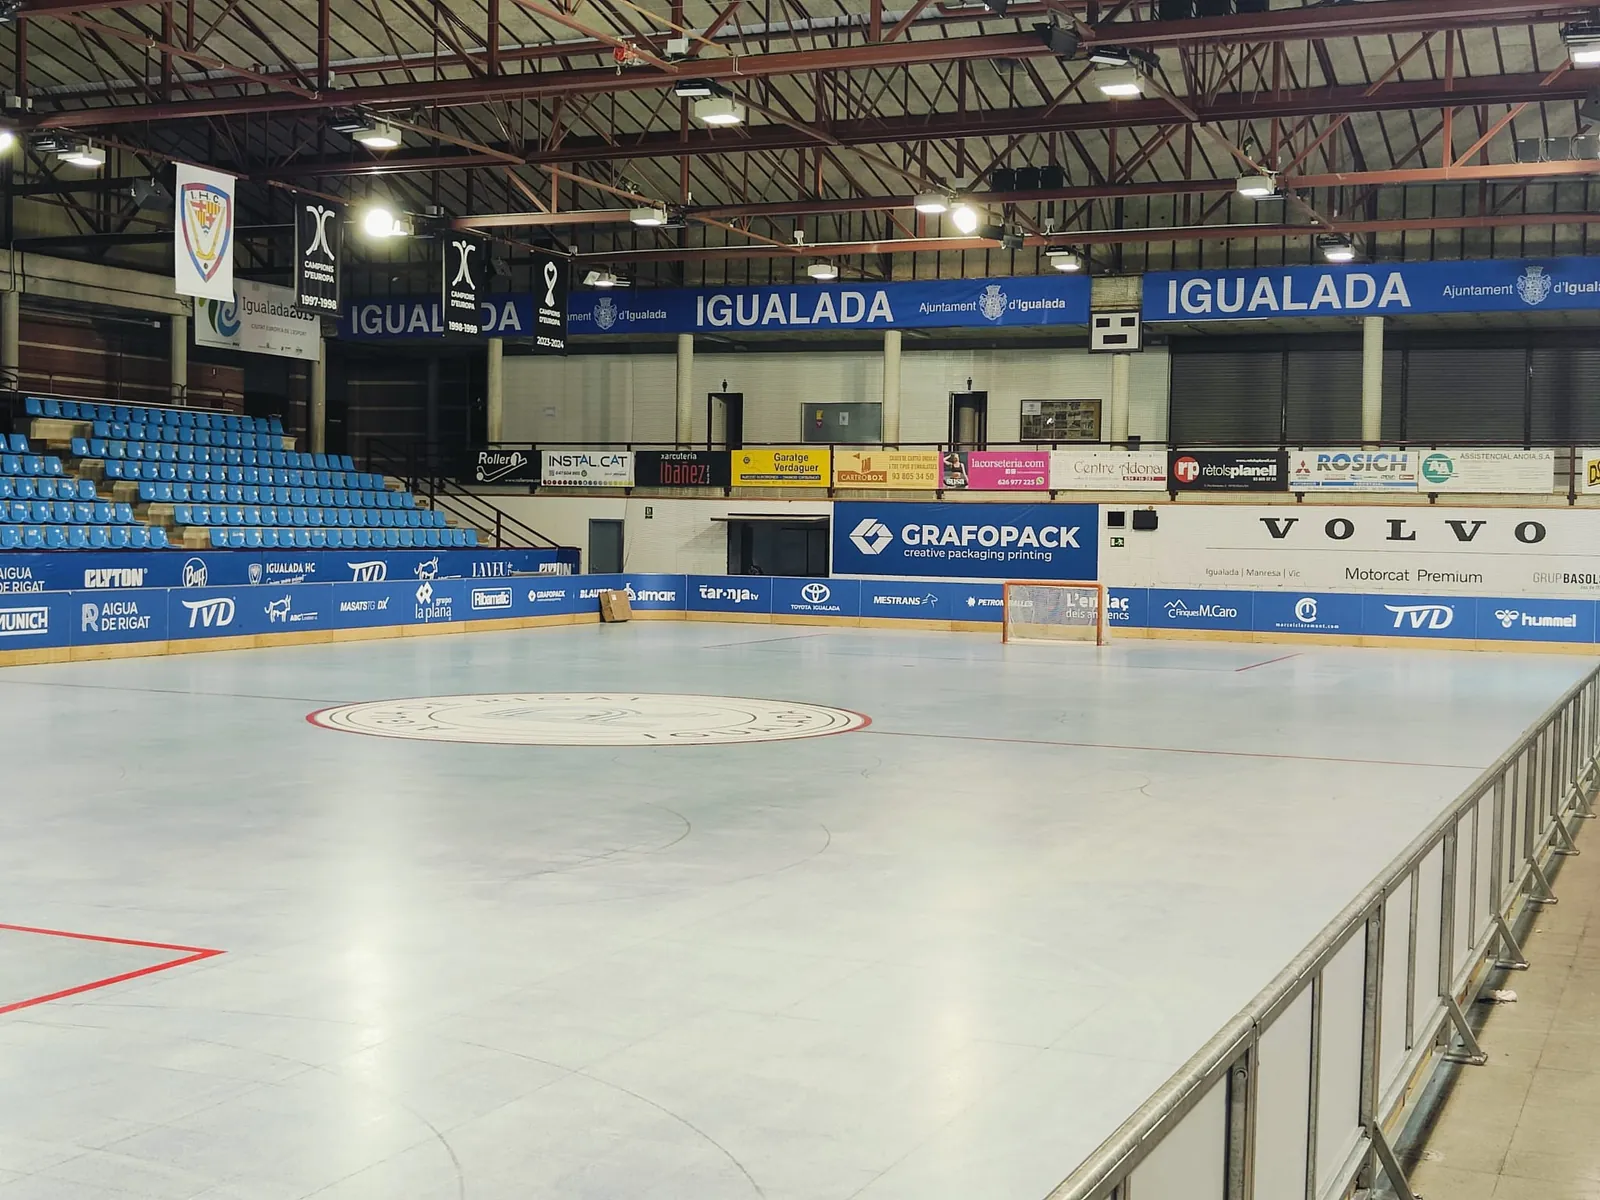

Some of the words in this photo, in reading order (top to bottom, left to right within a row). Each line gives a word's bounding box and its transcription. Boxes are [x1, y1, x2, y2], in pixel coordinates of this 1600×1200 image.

[304, 260, 334, 273] CAMPIONS
[304, 270, 335, 284] D'EUROPA
[451, 290, 475, 301] CAMPIONS
[1168, 271, 1412, 314] IGUALADA
[1442, 282, 1513, 298] Ajuntament
[301, 294, 337, 310] 1997-1998
[696, 290, 895, 327] IGUALADA
[919, 301, 976, 313] Ajuntament
[1008, 298, 1066, 312] d'Igualada
[352, 301, 522, 335] IGUALDA
[618, 309, 667, 322] d'Igualada
[548, 453, 628, 468] INSTAL.CAT
[660, 452, 698, 461] xarcuteria
[773, 452, 809, 464] Garatge
[971, 457, 1045, 469] lacorseteria.com
[1316, 453, 1408, 472] ROSICH
[773, 463, 819, 473] Verdaguer
[1073, 461, 1114, 475] Centre
[840, 473, 884, 482] CARTROBOX
[901, 523, 1081, 548] GRAFOPACK
[1259, 517, 1547, 544] VOLVO
[903, 548, 946, 558] creative
[948, 549, 1005, 562] packaging
[1007, 550, 1053, 563] printing
[0, 567, 33, 580] AIGUA
[266, 562, 303, 574] IGUALADA
[304, 562, 316, 573] HC
[1205, 567, 1240, 577] Igualada
[1344, 567, 1410, 582] Motorcat
[1417, 568, 1483, 583] Premium
[12, 580, 45, 592] RIGAT
[1563, 573, 1600, 585] BASOL
[873, 595, 921, 606] MESTRANS
[102, 601, 139, 616] AIGUA
[181, 597, 236, 629] TVD
[415, 603, 424, 619] la
[425, 603, 452, 623] plana
[1384, 603, 1454, 629] TVD
[0, 611, 49, 631] MUNICH
[102, 617, 117, 632] DE
[118, 615, 151, 631] RIGAT
[1521, 612, 1577, 628] hummel
